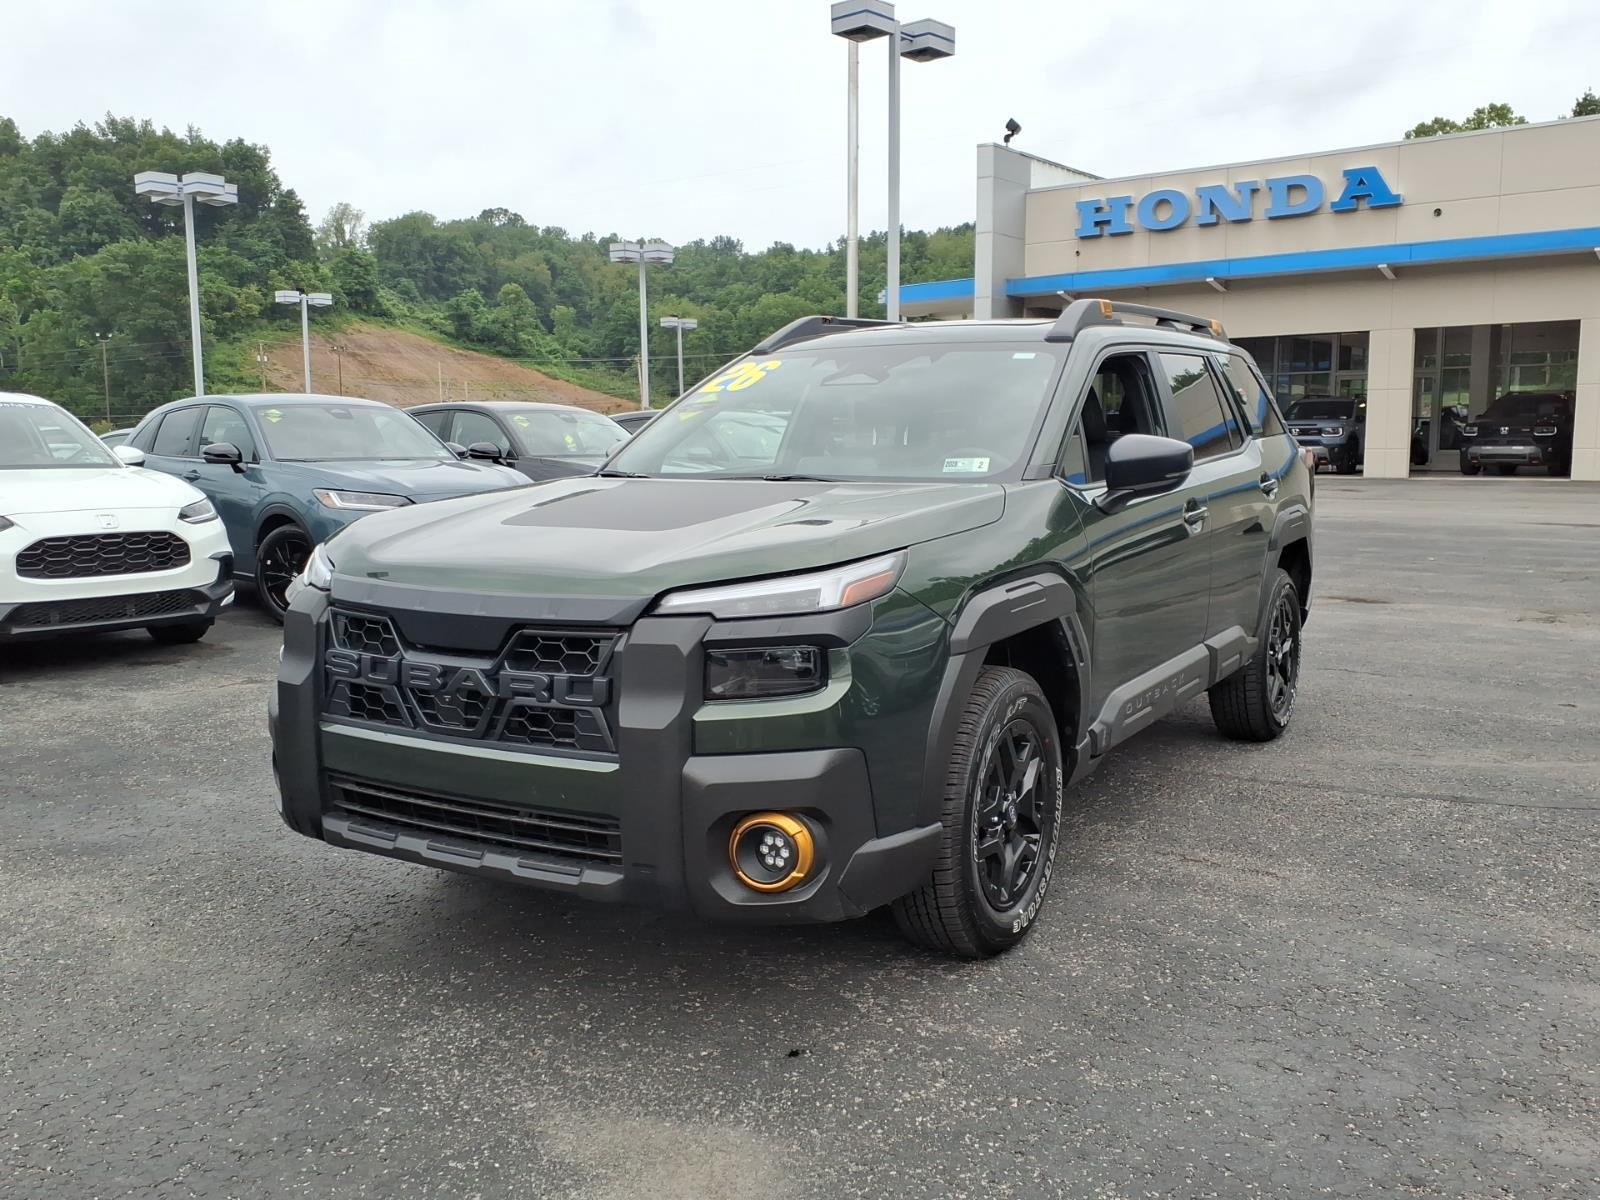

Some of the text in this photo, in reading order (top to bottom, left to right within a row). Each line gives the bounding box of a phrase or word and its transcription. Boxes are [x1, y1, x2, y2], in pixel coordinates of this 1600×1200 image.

[1075, 166, 1404, 239] HONDA
[325, 648, 612, 705] SUBARU
[1125, 673, 1185, 714] OUTBACK
